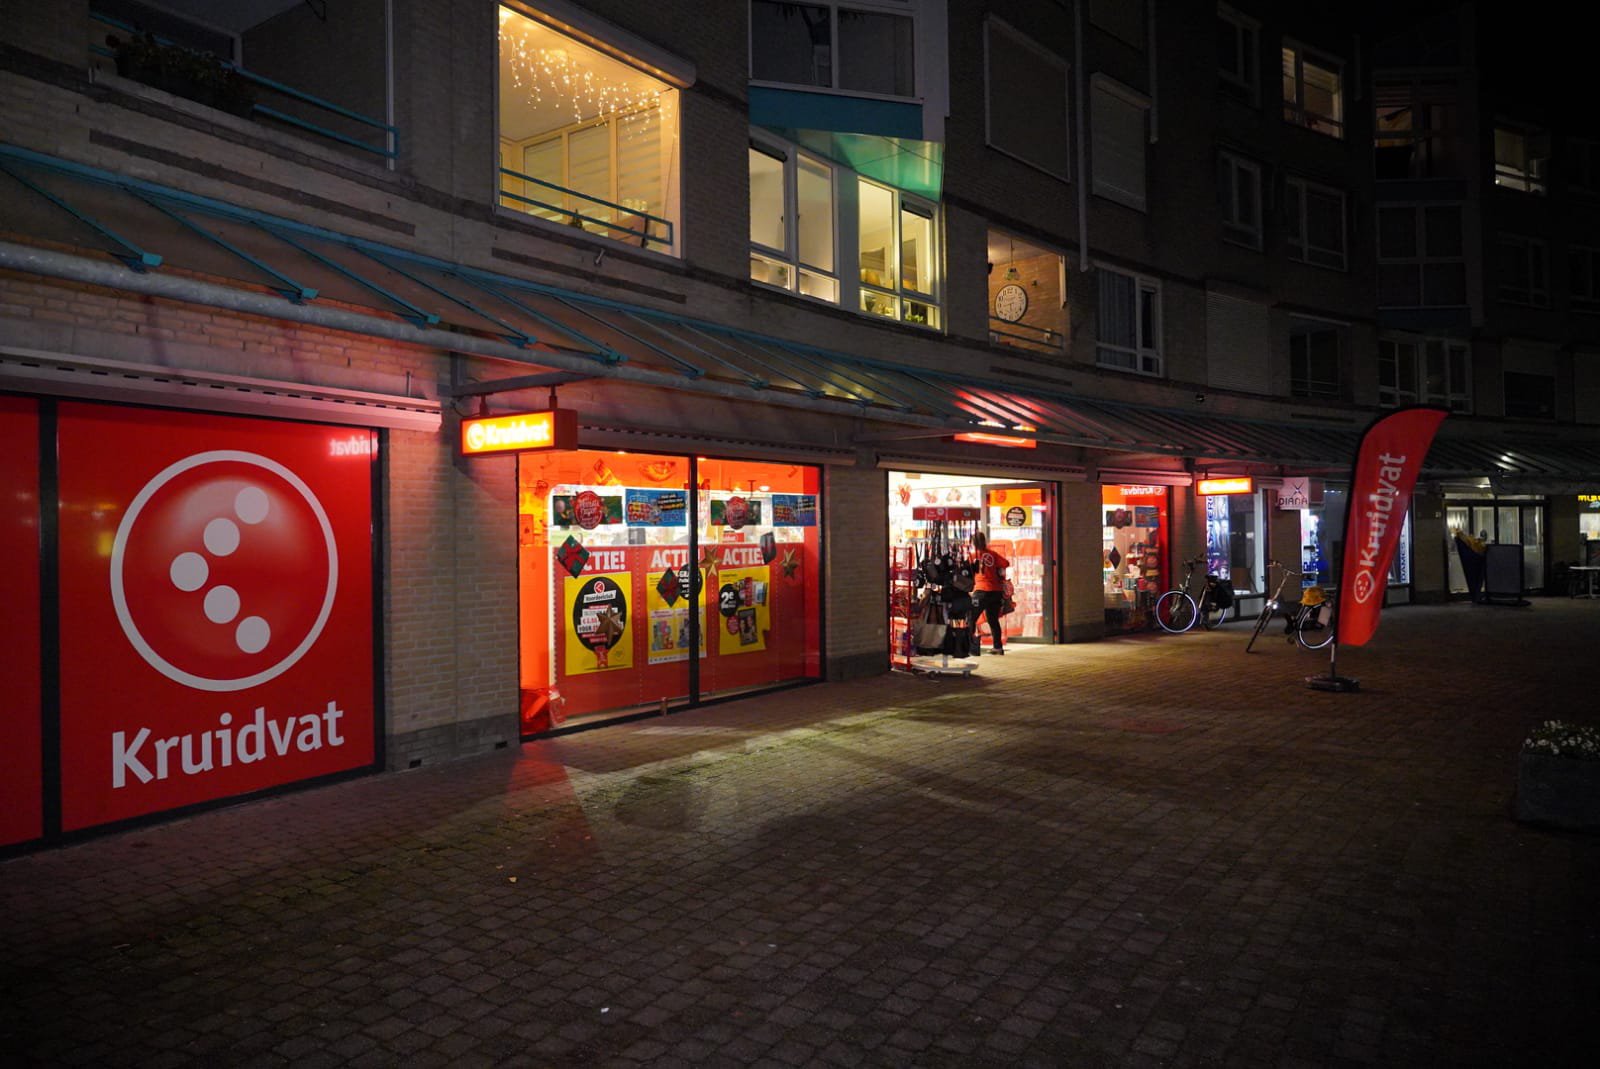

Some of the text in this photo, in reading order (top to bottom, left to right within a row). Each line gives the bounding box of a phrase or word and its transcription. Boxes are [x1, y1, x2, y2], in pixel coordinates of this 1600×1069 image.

[486, 419, 549, 445] Kruidvat
[1279, 497, 1308, 505] DIANA
[1360, 452, 1406, 567] Kruidvat
[582, 551, 626, 571] CTIE!
[112, 701, 345, 788] Kruidvat
